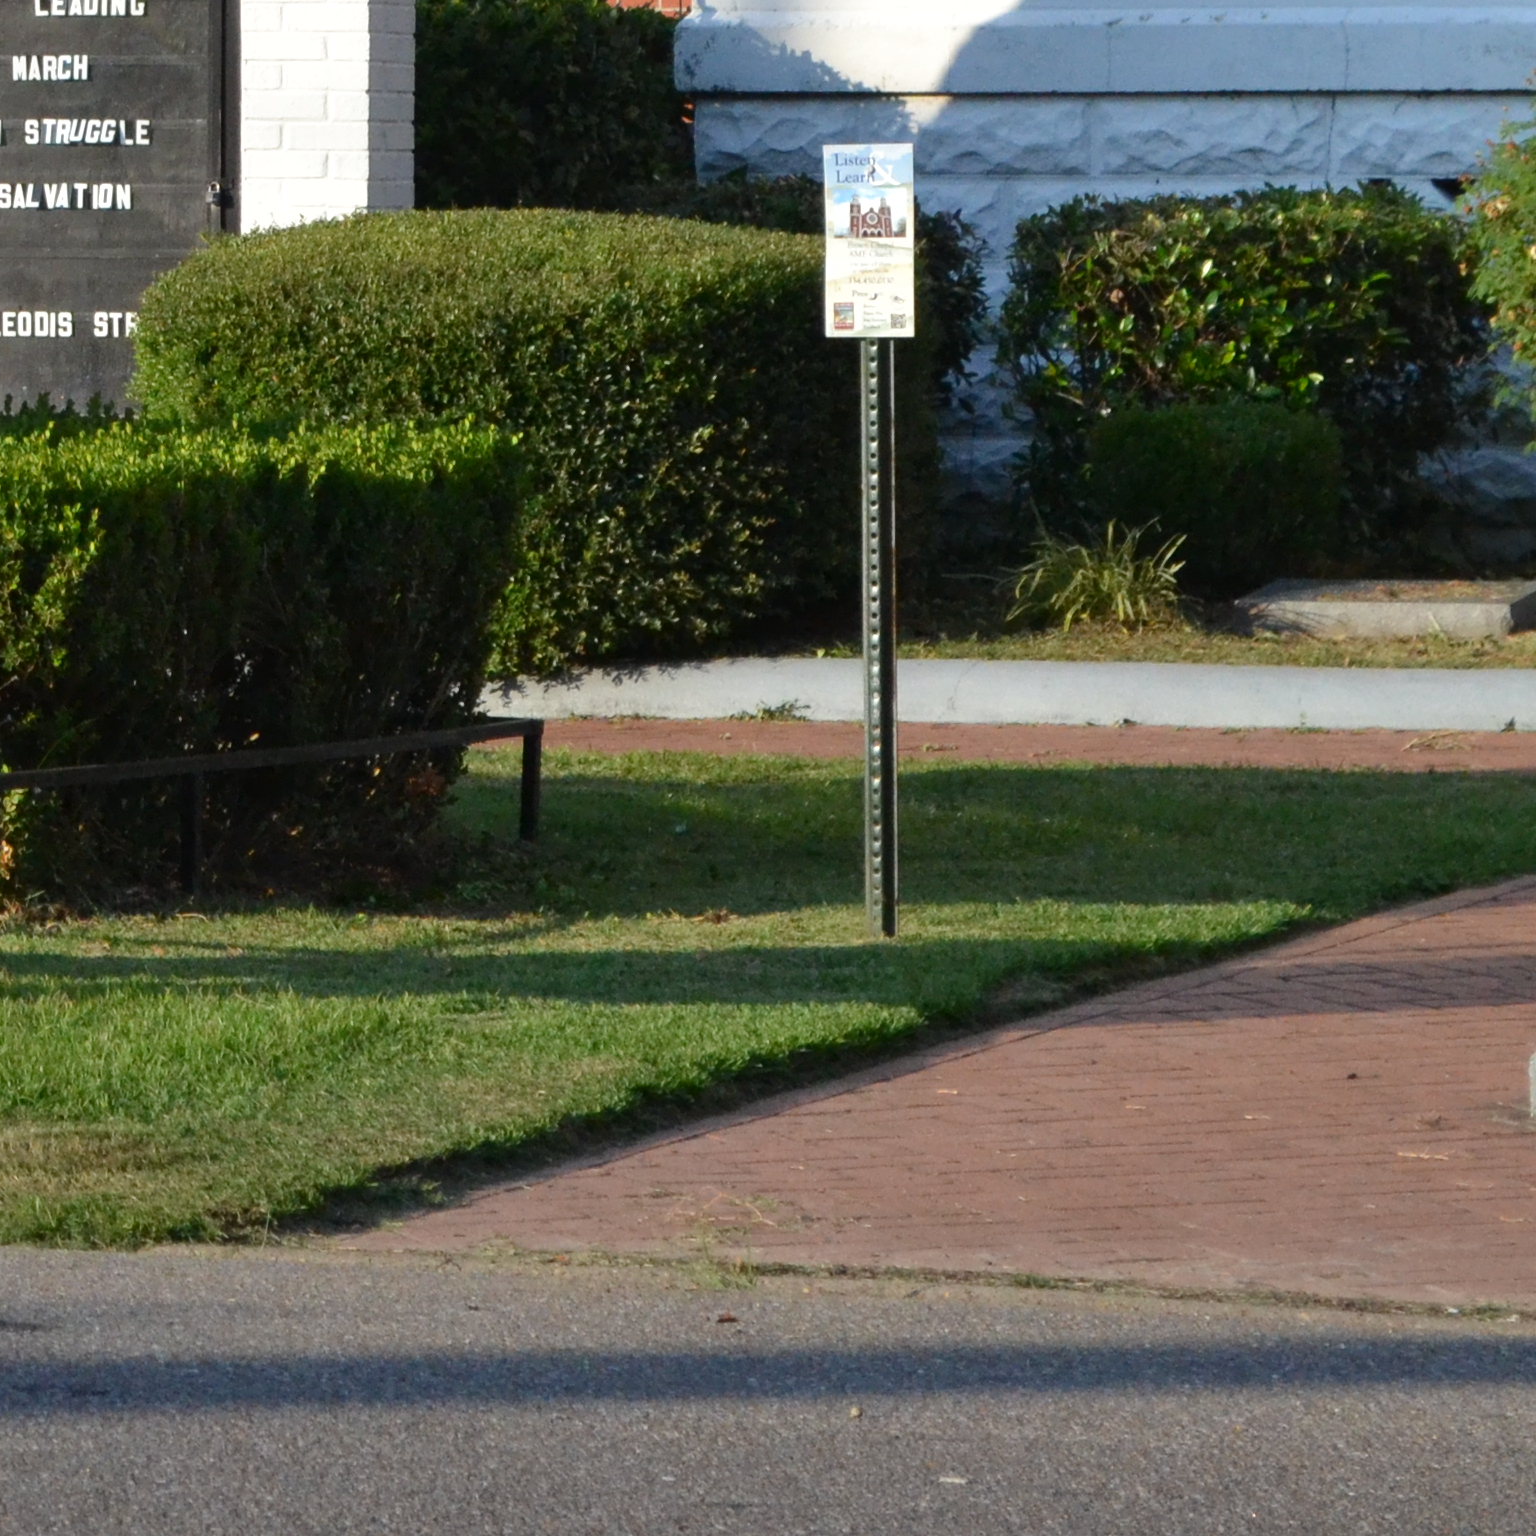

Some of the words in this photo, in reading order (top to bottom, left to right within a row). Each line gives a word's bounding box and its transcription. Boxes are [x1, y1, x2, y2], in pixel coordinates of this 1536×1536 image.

[12, 55, 89, 81] MARCH
[24, 118, 151, 146] STRUGGLE
[835, 152, 876, 167] Listen
